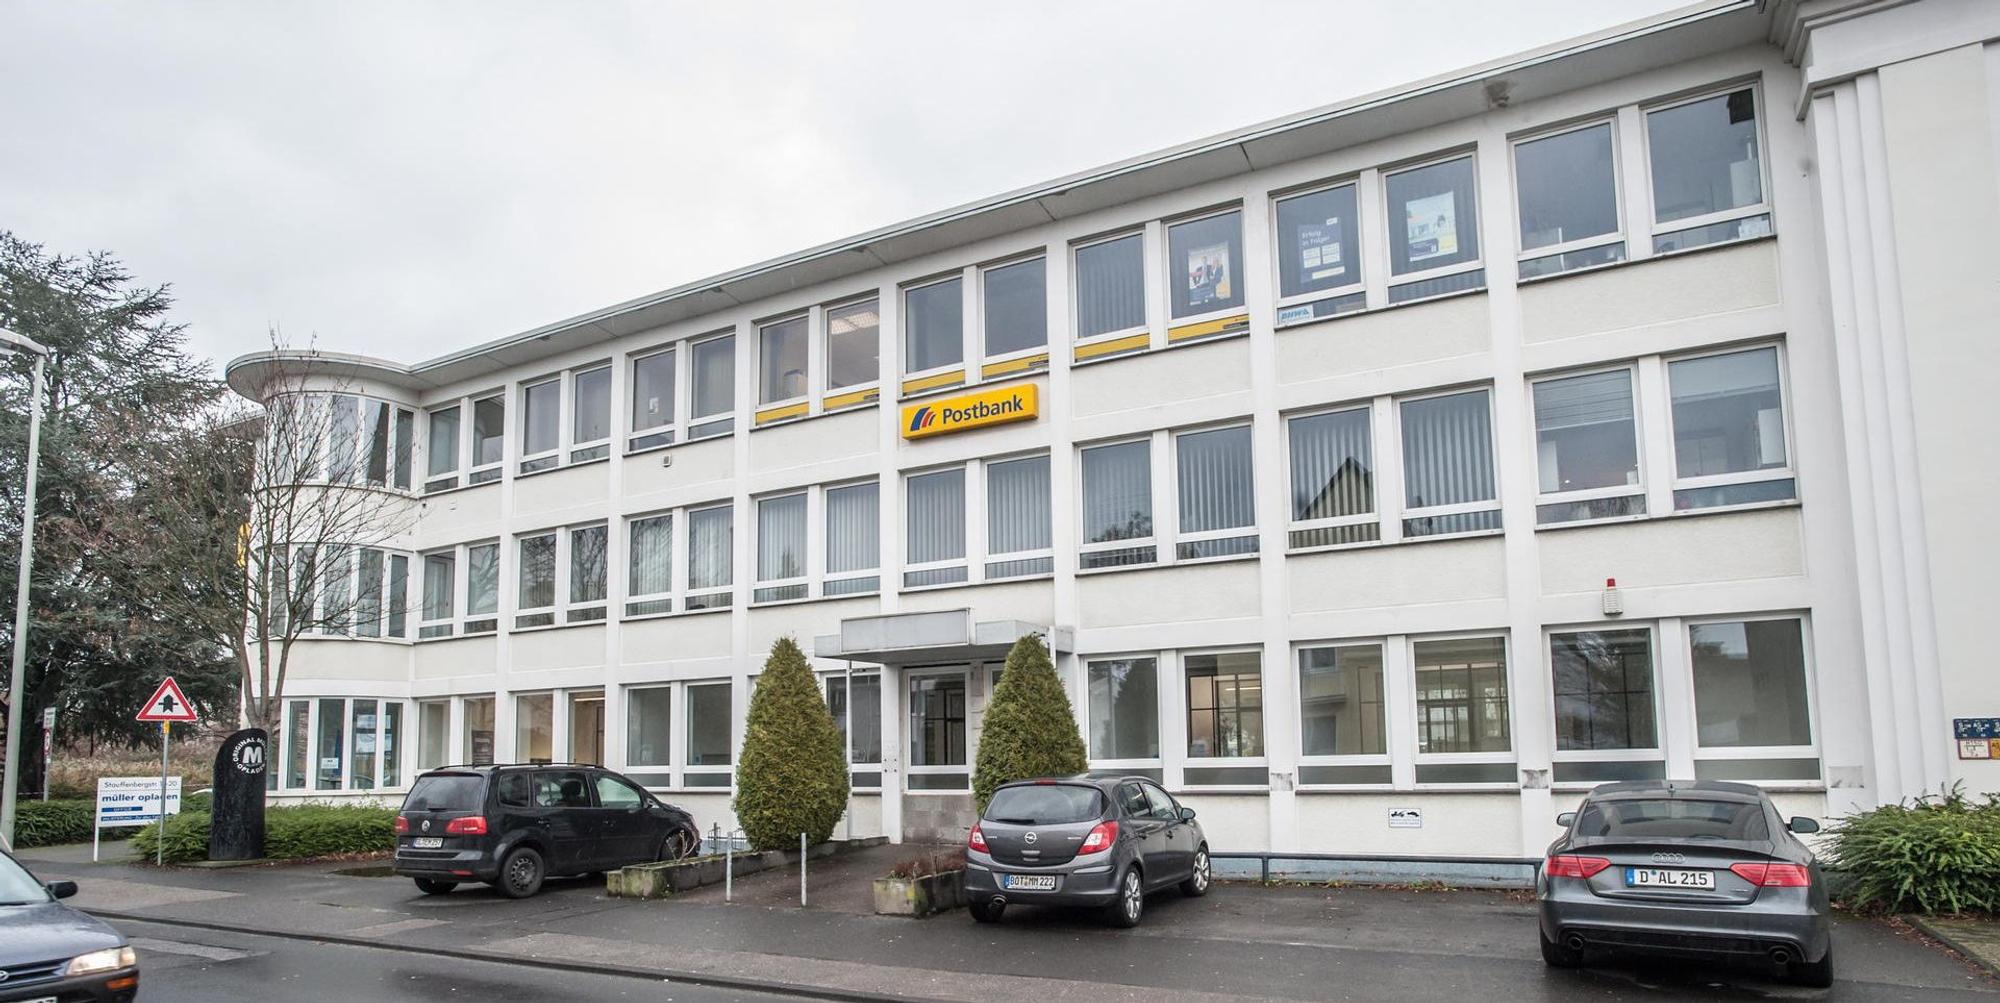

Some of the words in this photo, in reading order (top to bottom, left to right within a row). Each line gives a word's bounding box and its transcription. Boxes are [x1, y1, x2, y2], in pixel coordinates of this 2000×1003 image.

[942, 394, 1024, 424] Postbank
[232, 737, 256, 762] ORIGINAL
[242, 746, 263, 764] M
[102, 793, 135, 802] müller
[138, 793, 178, 802] oplaen
[1010, 875, 1024, 886] BOT
[1040, 876, 1053, 886] 222
[1640, 871, 1649, 883] D
[1658, 871, 1677, 885] AL
[1680, 872, 1708, 885] 215
